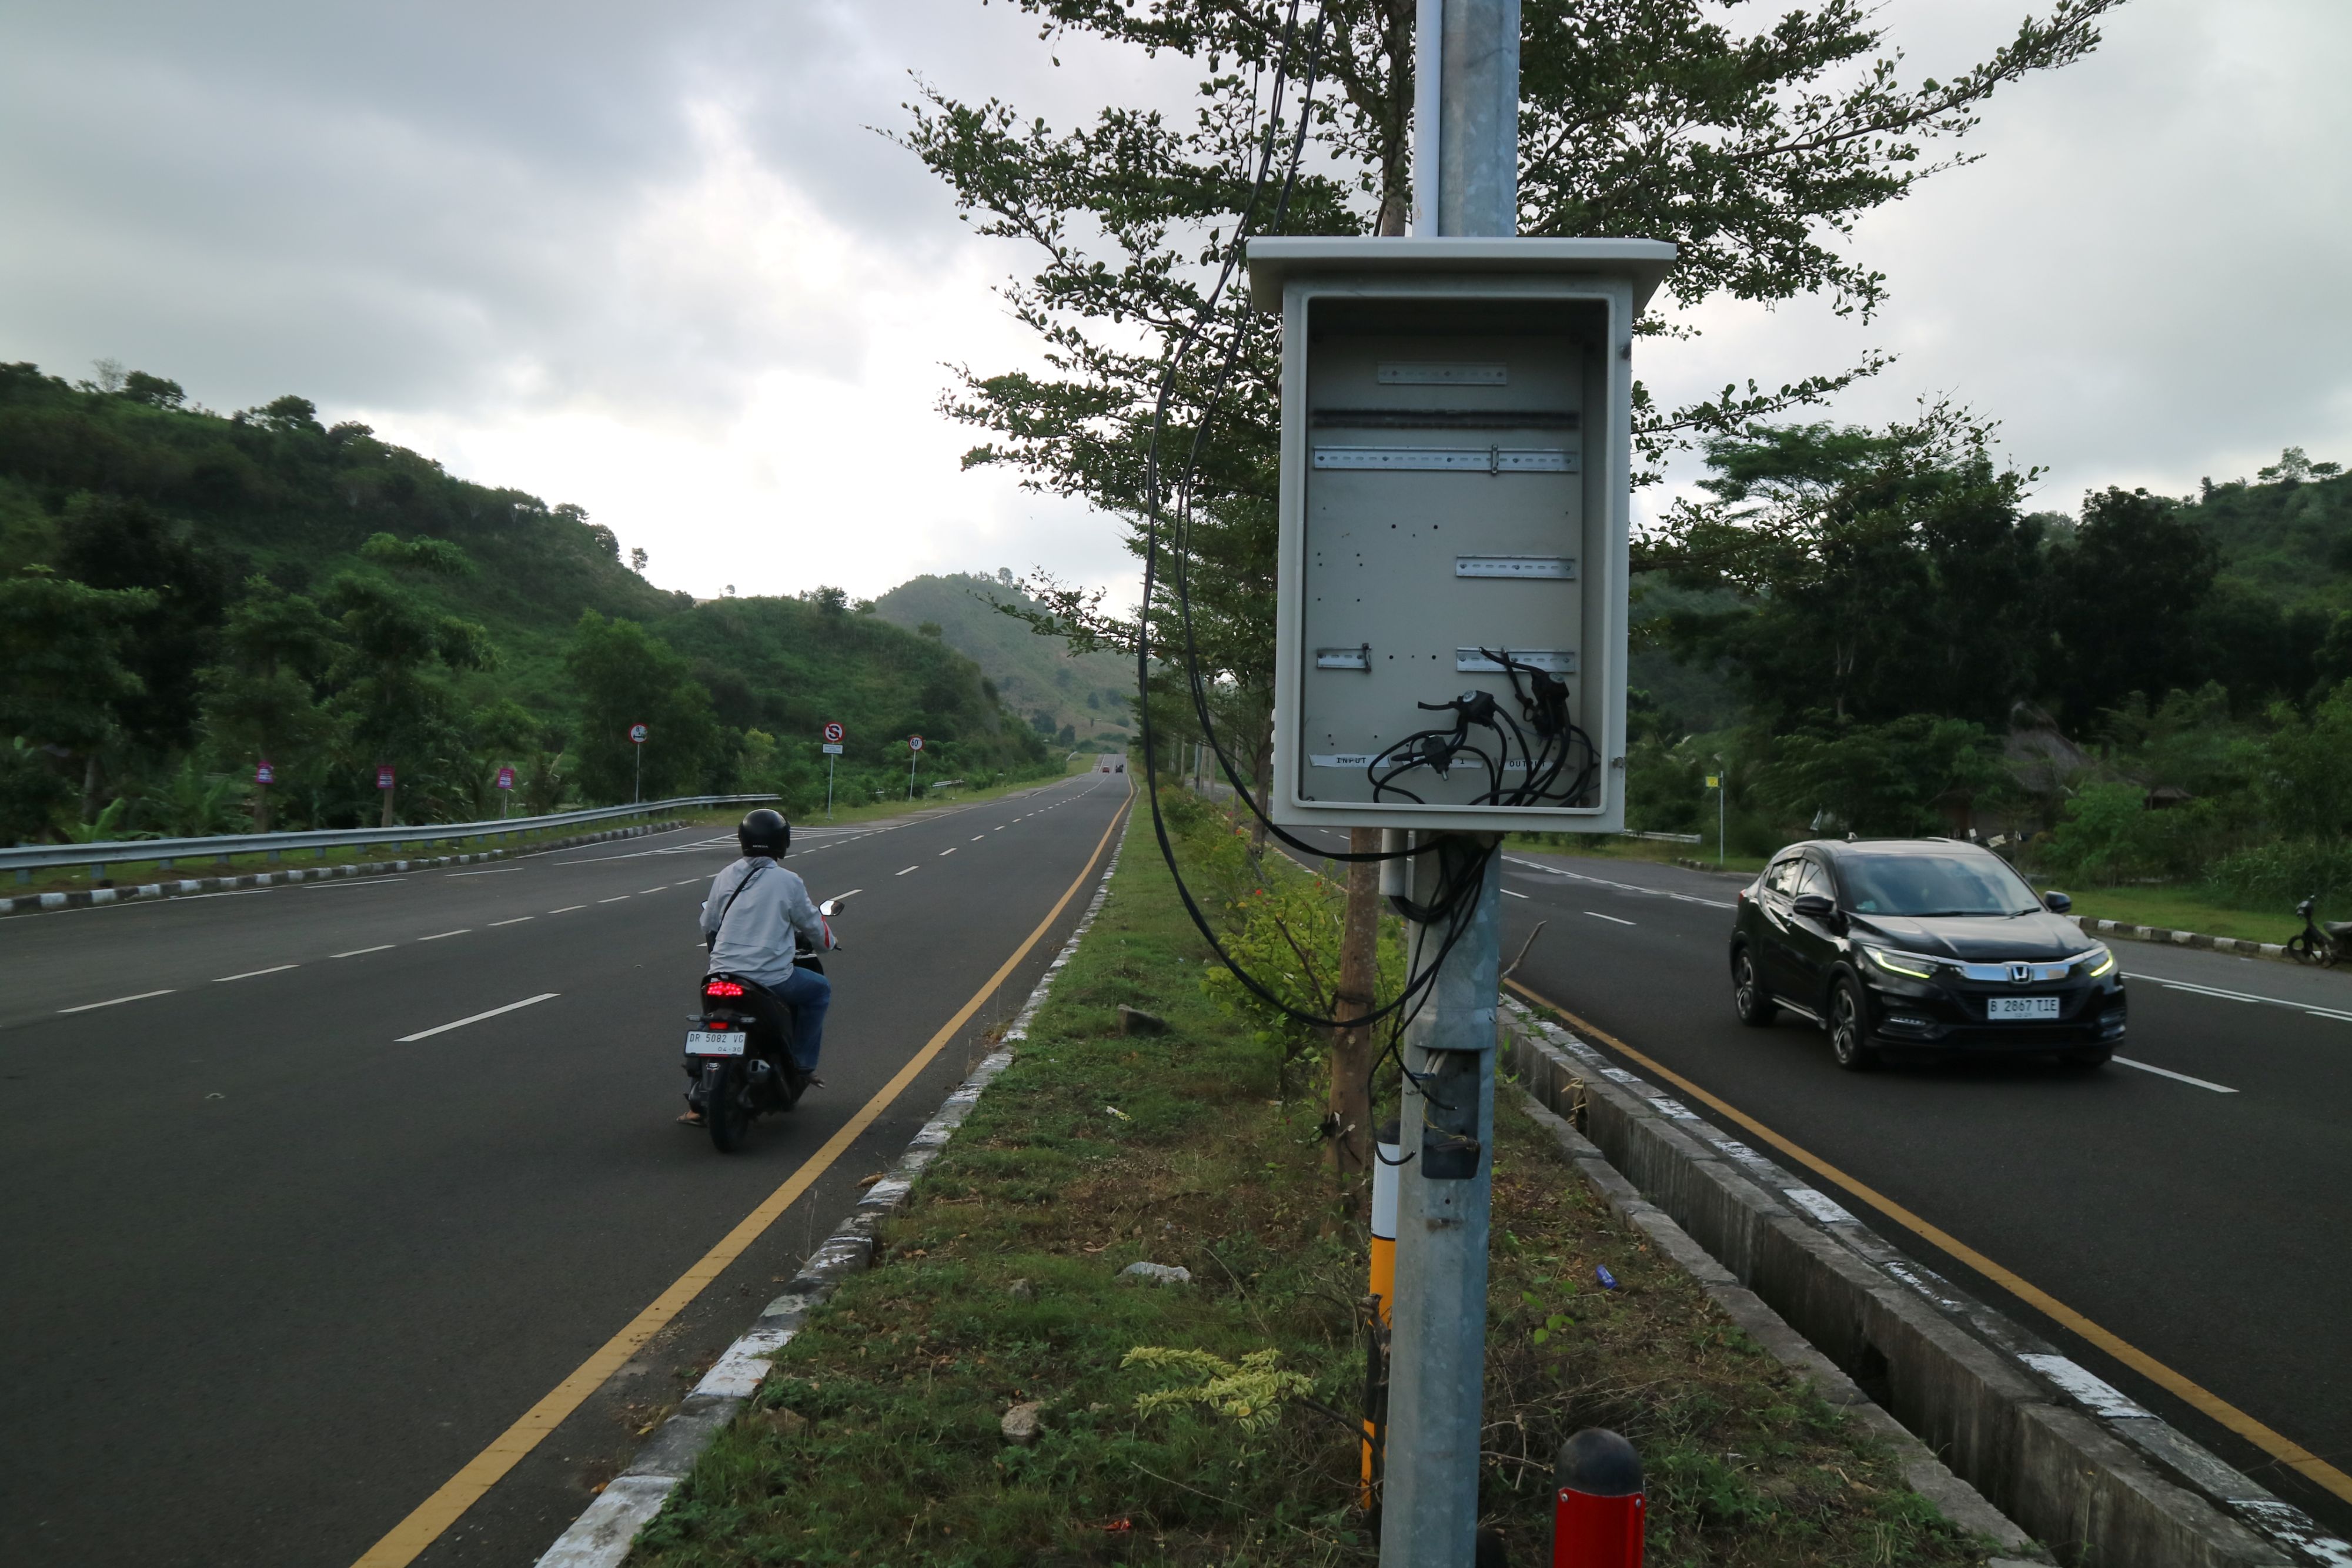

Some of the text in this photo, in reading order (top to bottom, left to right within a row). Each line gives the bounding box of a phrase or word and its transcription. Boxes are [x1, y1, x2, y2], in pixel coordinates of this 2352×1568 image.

[828, 726, 840, 739] S
[1990, 999, 2057, 1012] B 2867 TIE
[689, 1034, 700, 1042] DR
[706, 1034, 727, 1043] 5082
